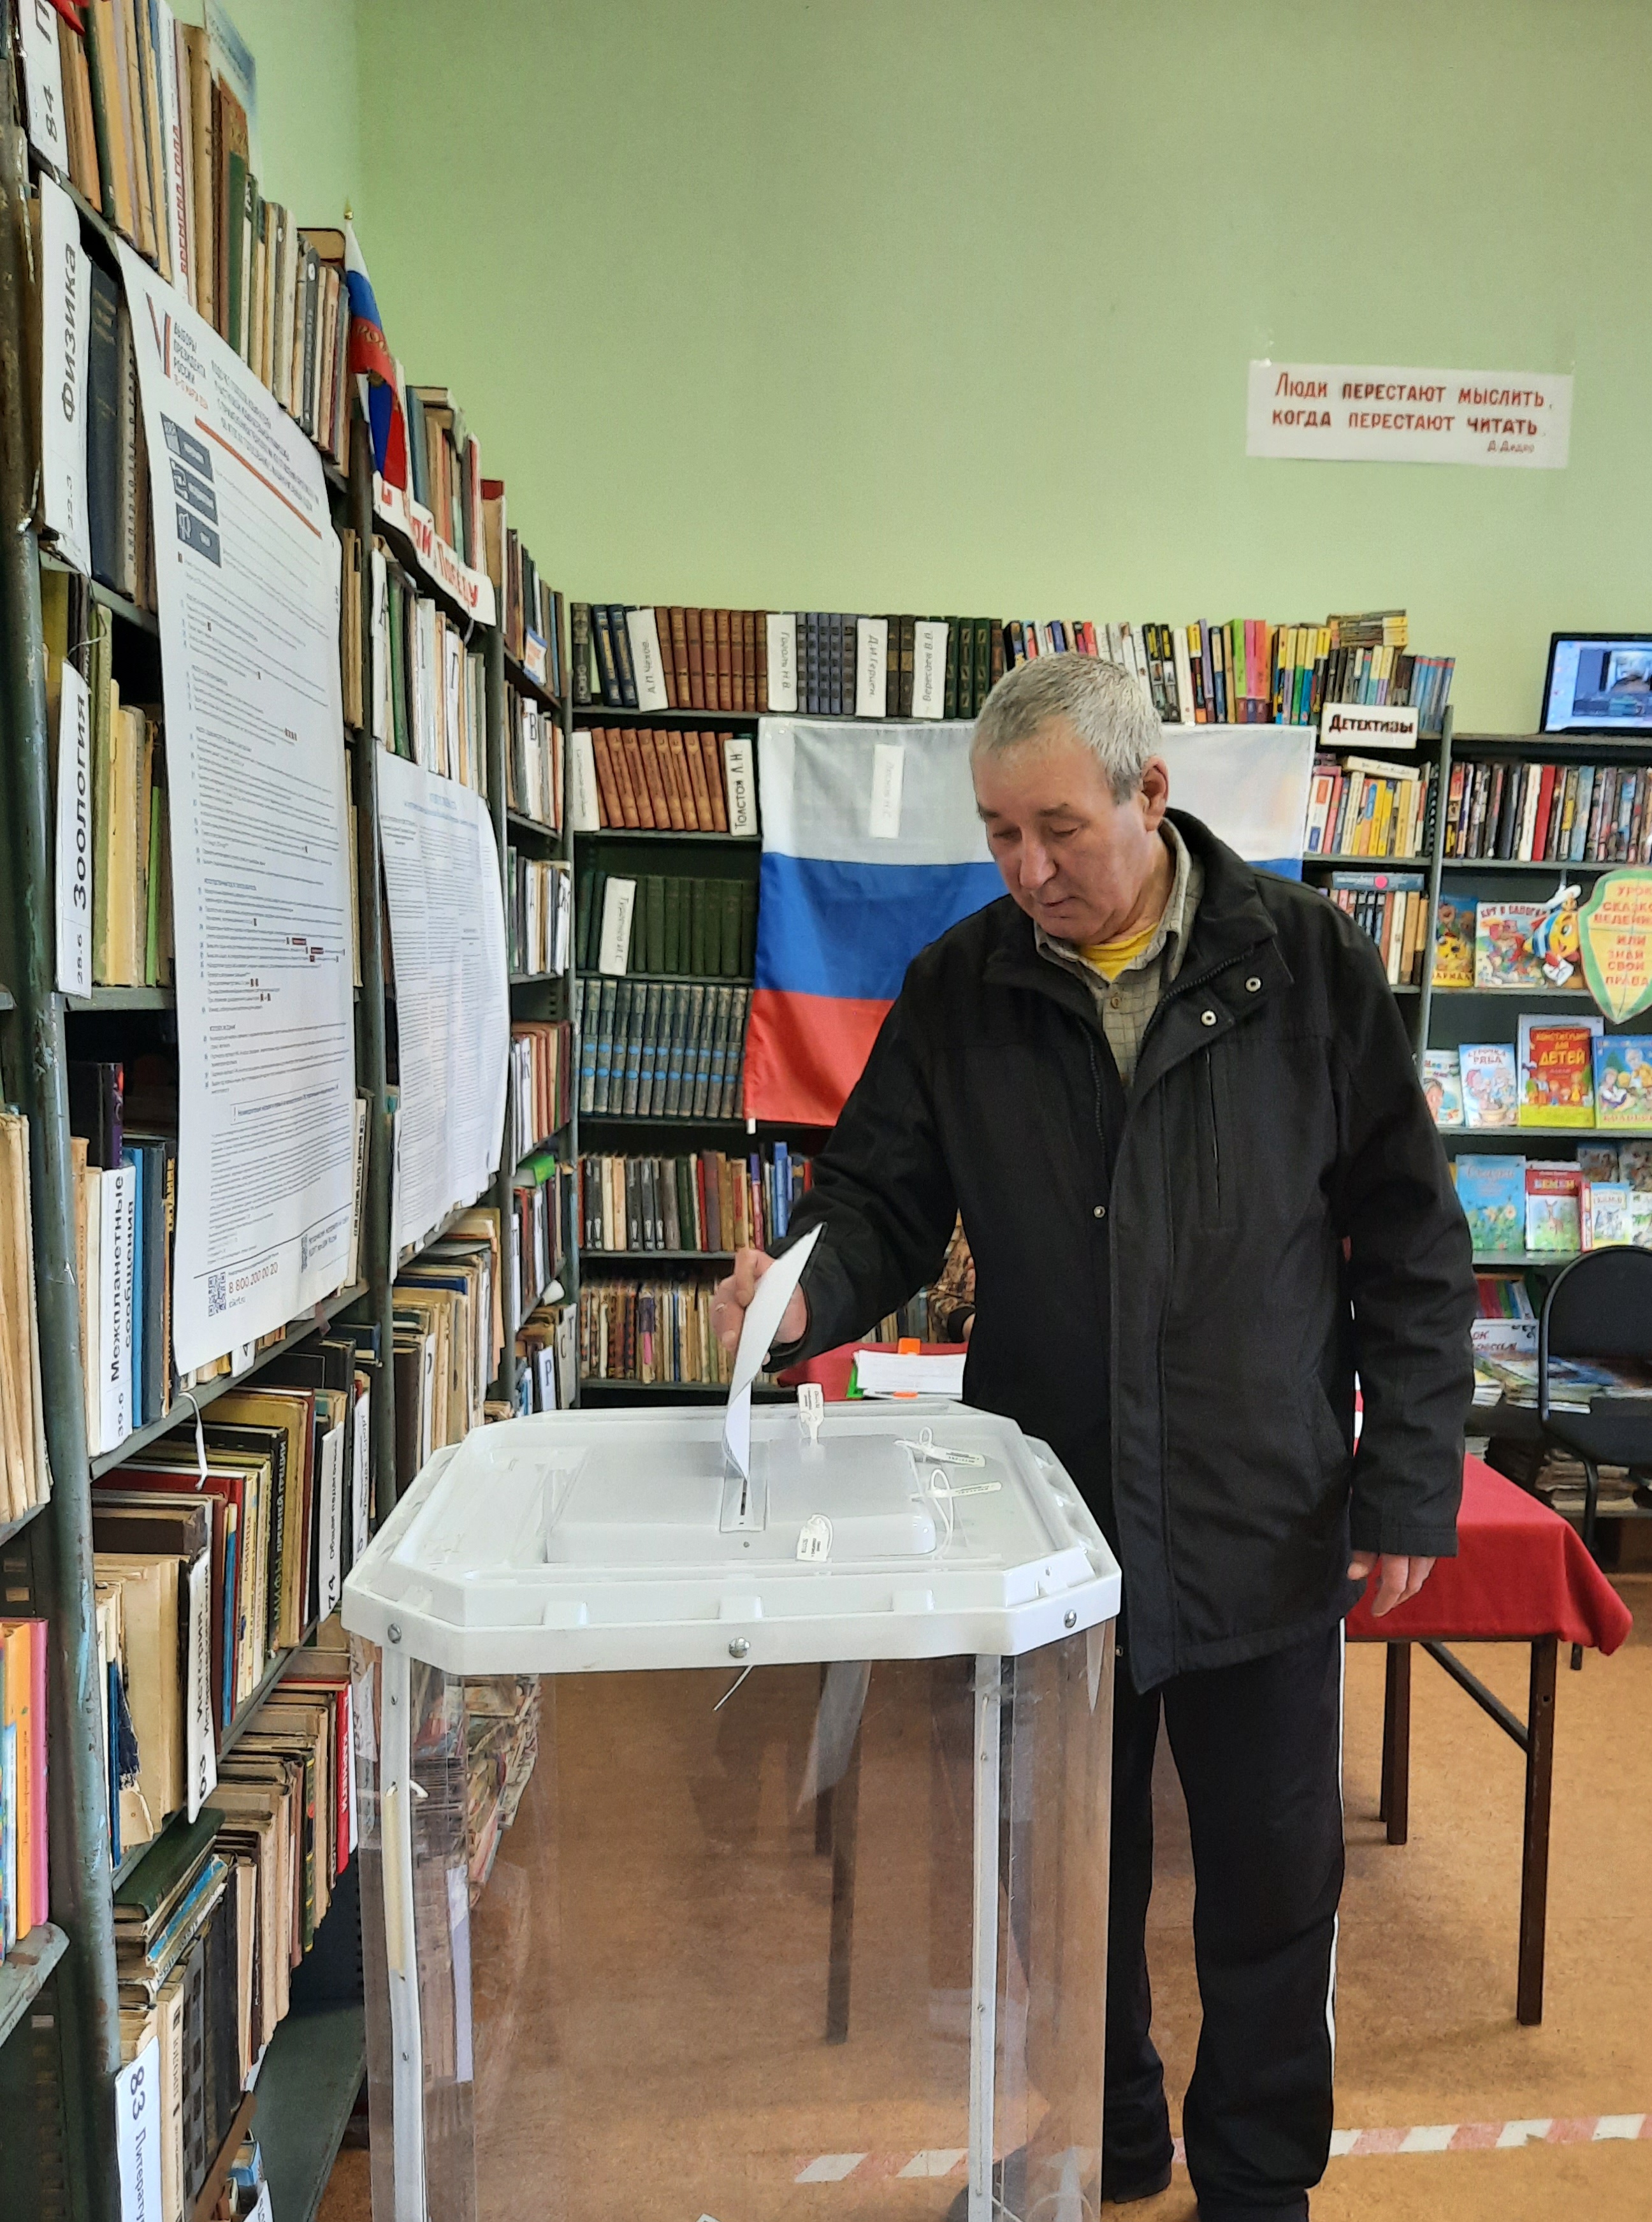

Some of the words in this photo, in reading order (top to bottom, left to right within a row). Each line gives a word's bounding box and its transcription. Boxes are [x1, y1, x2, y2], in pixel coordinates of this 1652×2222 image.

[1342, 382, 1447, 403] ПЕРЕСТАЮТ
[1272, 409, 1331, 428] КОГДА
[1348, 412, 1456, 432] ПЕРЕСТАЮТ
[1538, 1050, 1586, 1066] ДЕТЕЙ
[273, 1557, 282, 1622] МИФЫ
[129, 2066, 145, 2121] 83
